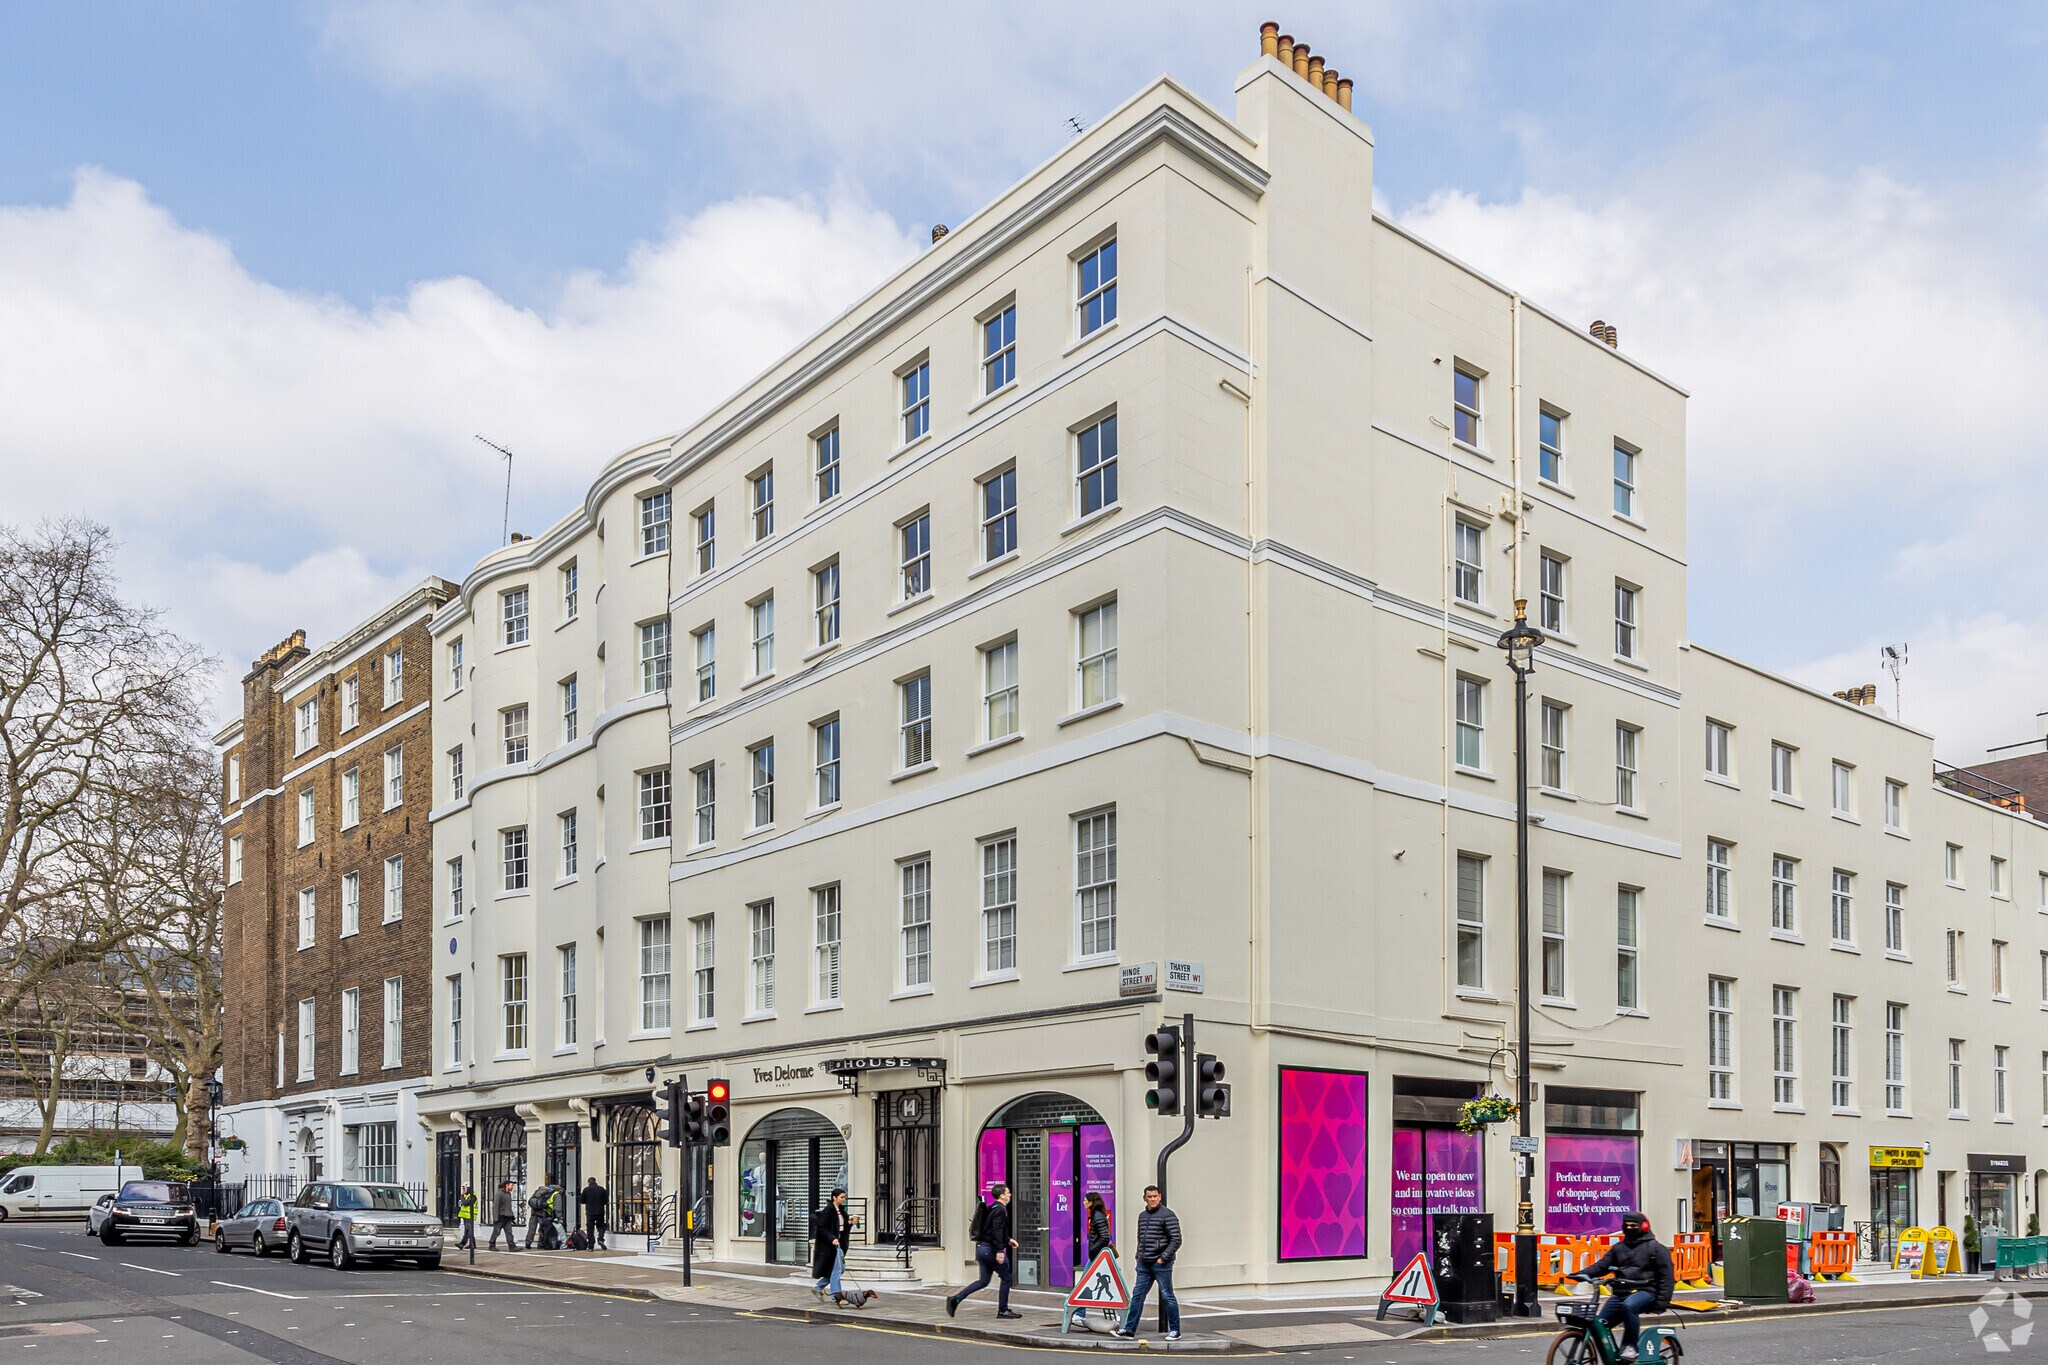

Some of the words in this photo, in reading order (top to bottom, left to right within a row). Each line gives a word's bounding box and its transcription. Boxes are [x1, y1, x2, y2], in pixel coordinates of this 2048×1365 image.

[1122, 967, 1141, 977] HINDE
[1169, 962, 1190, 972] THAYER
[1122, 975, 1143, 986] STREET
[1144, 974, 1153, 983] W1
[1169, 971, 1190, 981] STREET
[1192, 974, 1201, 982] W1
[843, 1059, 912, 1069] HOUSE
[753, 1068, 773, 1083] Yves
[774, 1064, 814, 1081] Delorme
[1885, 1149, 1899, 1157] PHOTO
[1891, 1158, 1917, 1166] SPECIALISTS
[1396, 1170, 1410, 1180] We
[1426, 1173, 1446, 1184] open
[1447, 1172, 1456, 1180] to
[1457, 1173, 1474, 1181] new
[1556, 1172, 1581, 1182] Perfect
[1582, 1172, 1592, 1182] for
[1602, 1175, 1621, 1185] array
[1395, 1187, 1410, 1198] and
[1455, 1187, 1475, 1198] ideas
[1557, 1188, 1566, 1197] of
[1566, 1188, 1599, 1200] shopping,
[1600, 1188, 1621, 1200] eating
[1057, 1194, 1067, 1203] To
[1056, 1203, 1068, 1212] Let
[1392, 1207, 1401, 1215] so
[1426, 1204, 1441, 1214] and
[1442, 1204, 1458, 1214] talk
[1460, 1205, 1469, 1214] to
[1469, 1206, 1478, 1214] us
[1548, 1203, 1562, 1213] and
[1563, 1203, 1590, 1215] lifestyle
[1591, 1203, 1630, 1215] experiences
